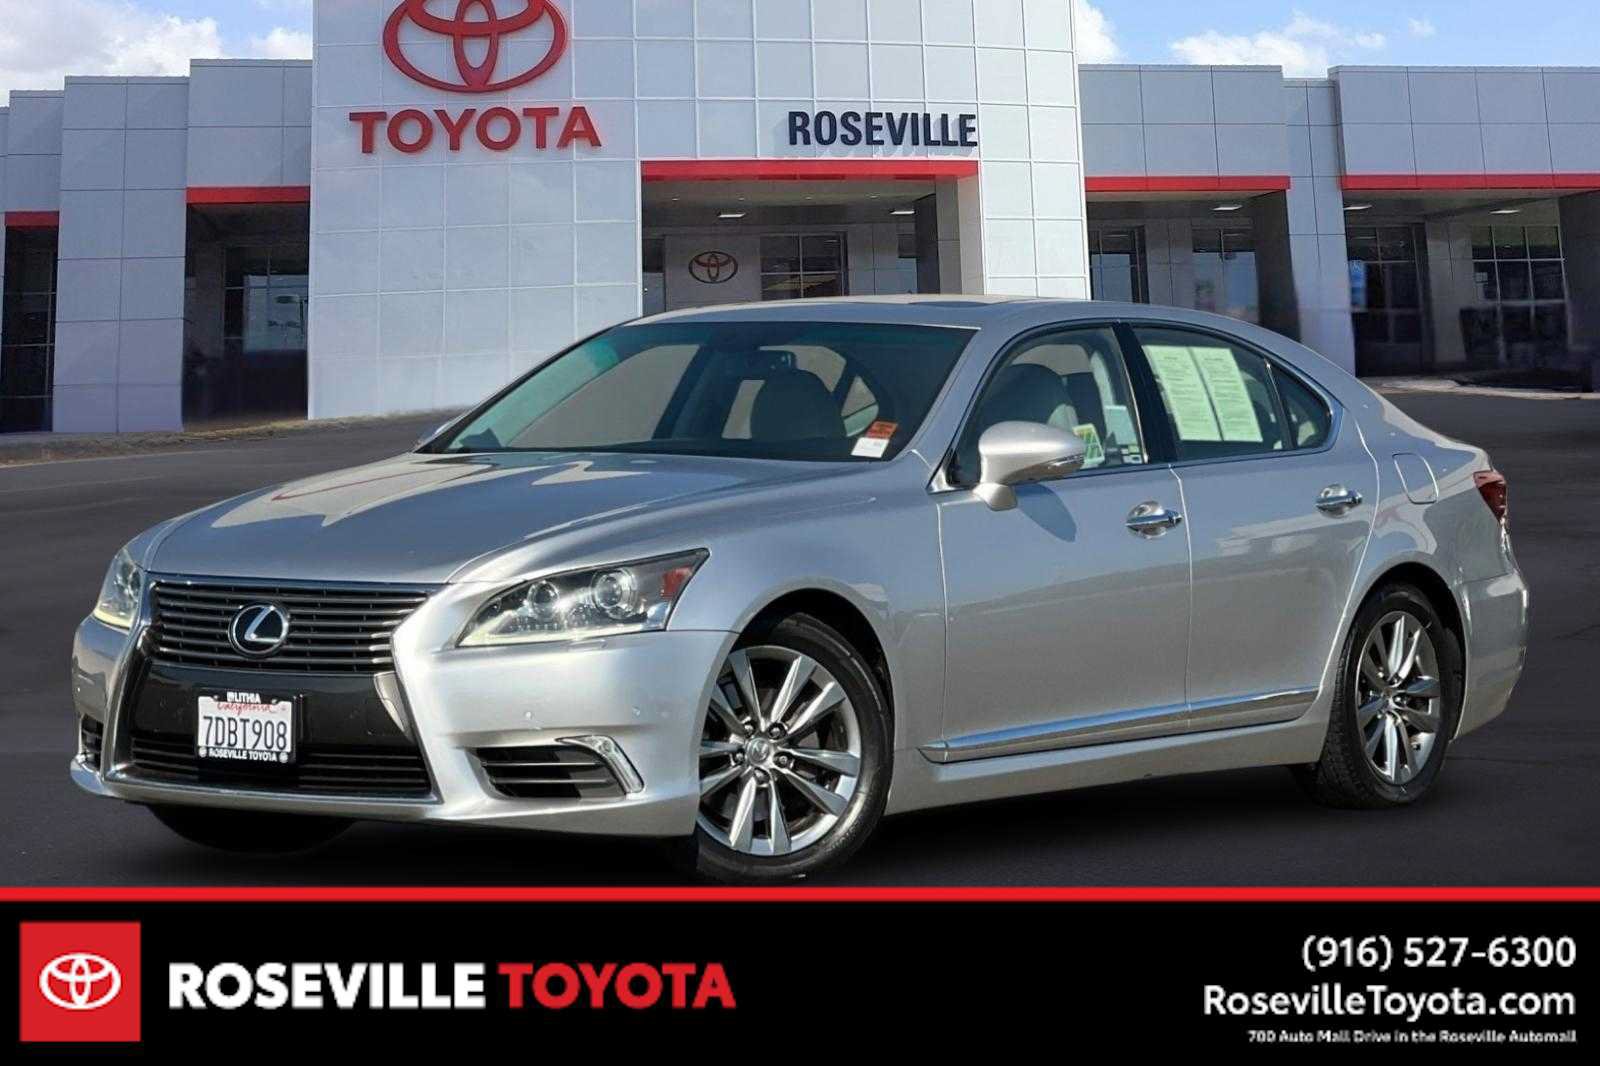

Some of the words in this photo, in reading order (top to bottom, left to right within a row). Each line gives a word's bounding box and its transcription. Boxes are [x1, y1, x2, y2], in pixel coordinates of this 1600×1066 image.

[349, 106, 602, 154] TOYOTA
[788, 110, 978, 147] ROSEVILLE
[202, 715, 288, 751] 7DBT908
[208, 748, 248, 760] ROSEVILLE
[248, 751, 278, 762] TOYOTA
